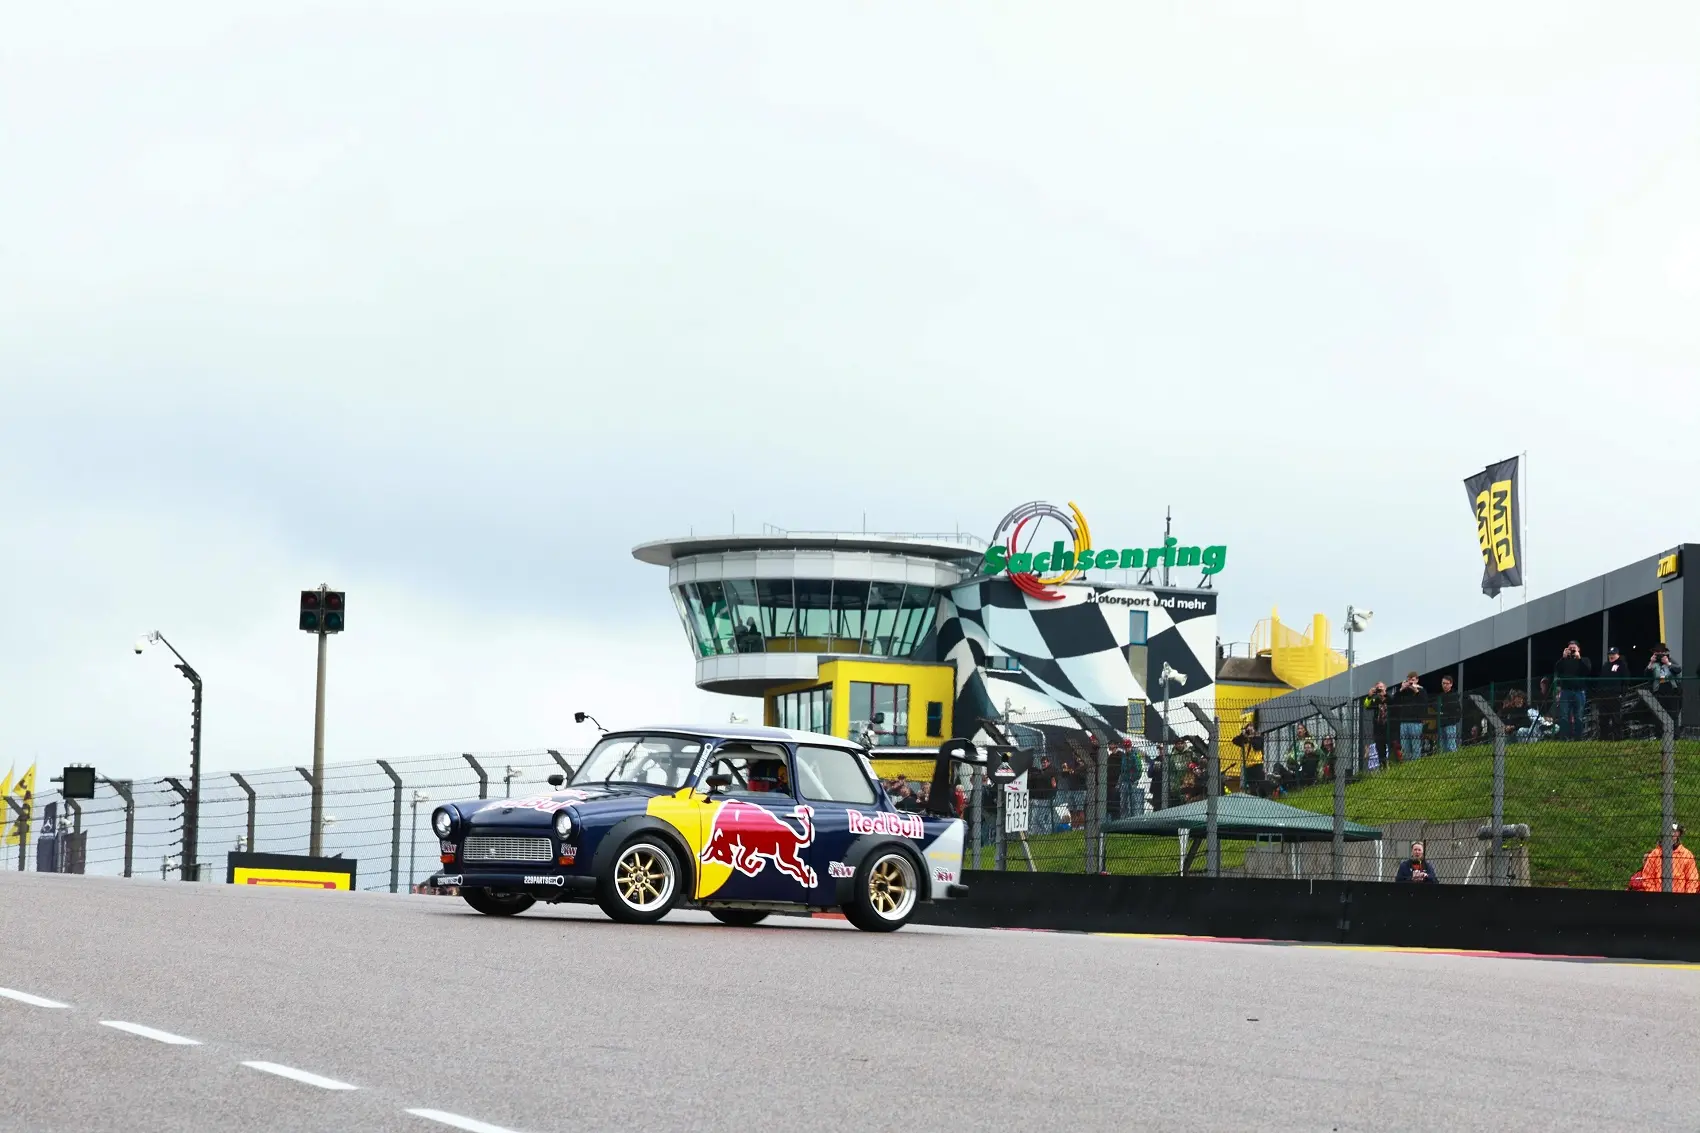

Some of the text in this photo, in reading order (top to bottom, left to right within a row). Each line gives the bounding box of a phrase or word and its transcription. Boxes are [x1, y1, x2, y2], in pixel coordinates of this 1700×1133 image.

[984, 537, 1227, 576] Sachsenring
[1087, 592, 1207, 610] Motorsport und mehr
[1007, 792, 1028, 809] F 13.6
[846, 809, 924, 838] Red Bull
[1007, 811, 1027, 829] T 13.7
